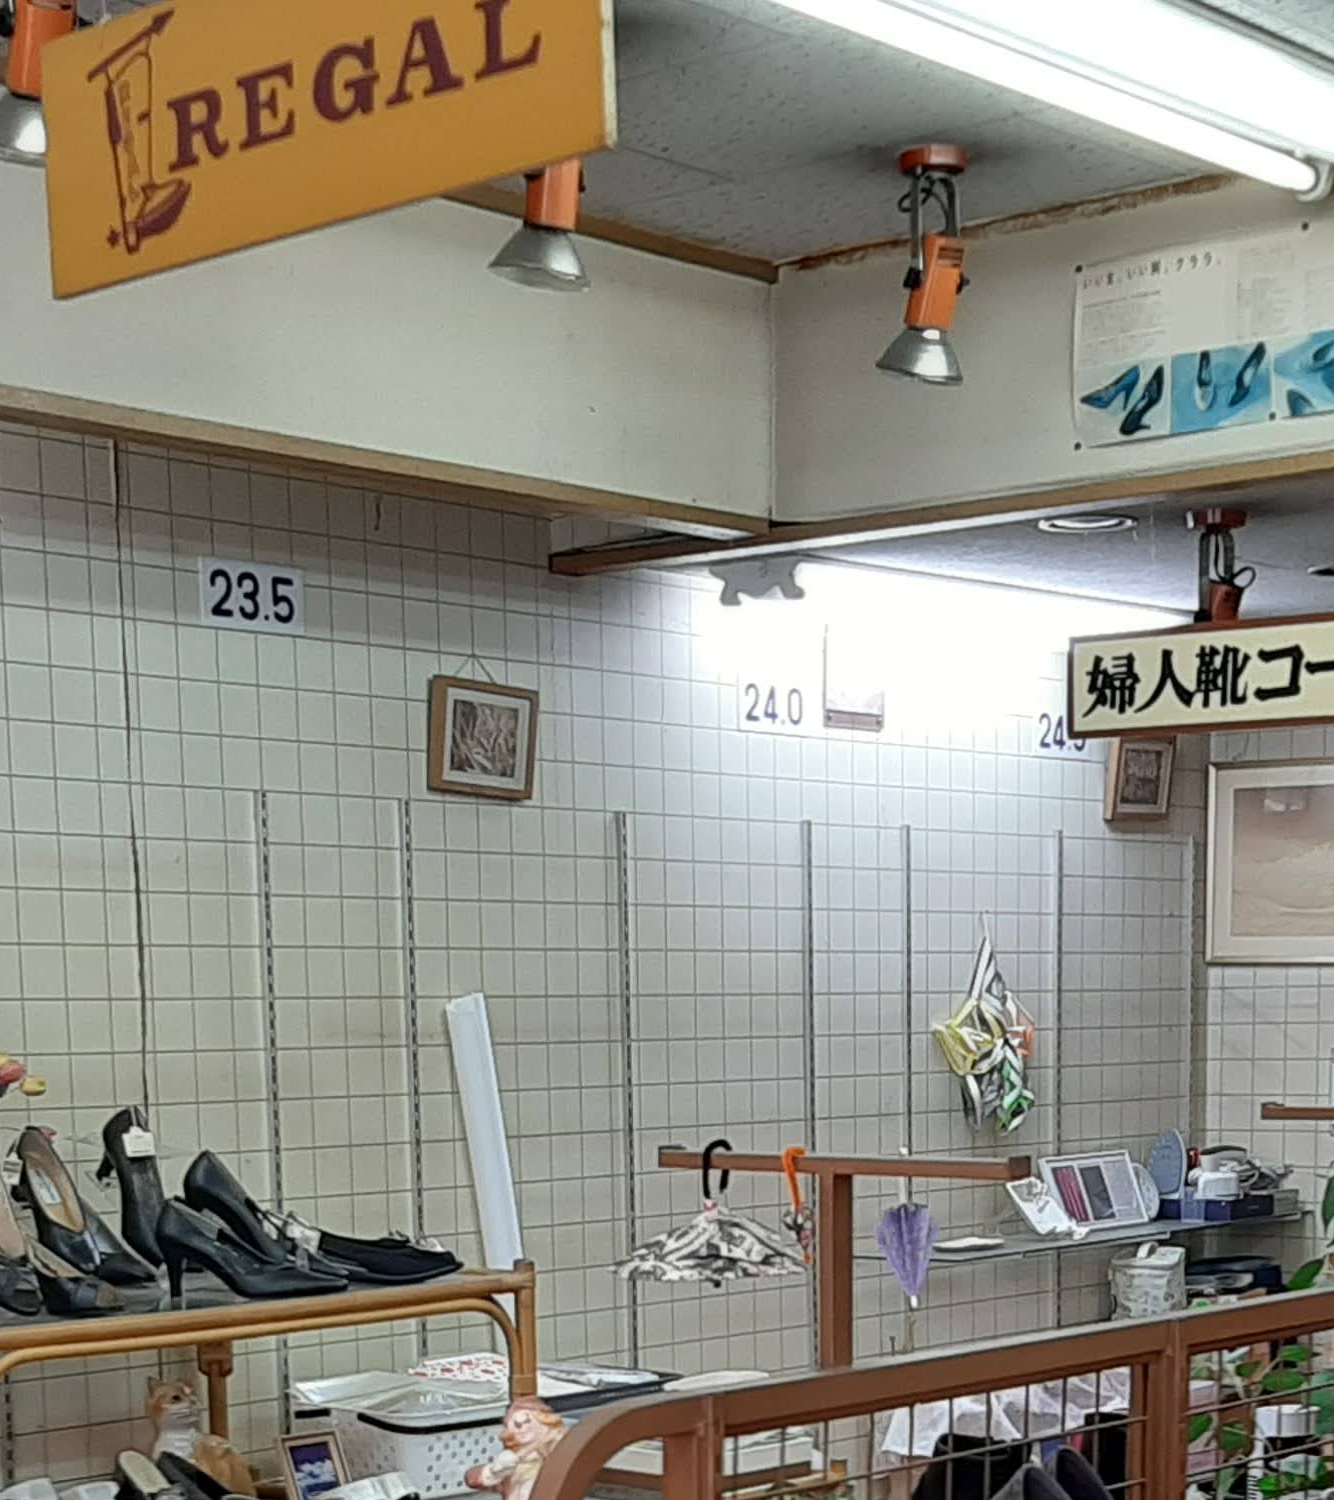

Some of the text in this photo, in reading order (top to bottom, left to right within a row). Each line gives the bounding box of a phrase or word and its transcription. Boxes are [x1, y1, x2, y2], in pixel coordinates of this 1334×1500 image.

[167, 0, 542, 173] REGAL
[209, 568, 295, 624] 23.5
[744, 683, 804, 726] 24.0
